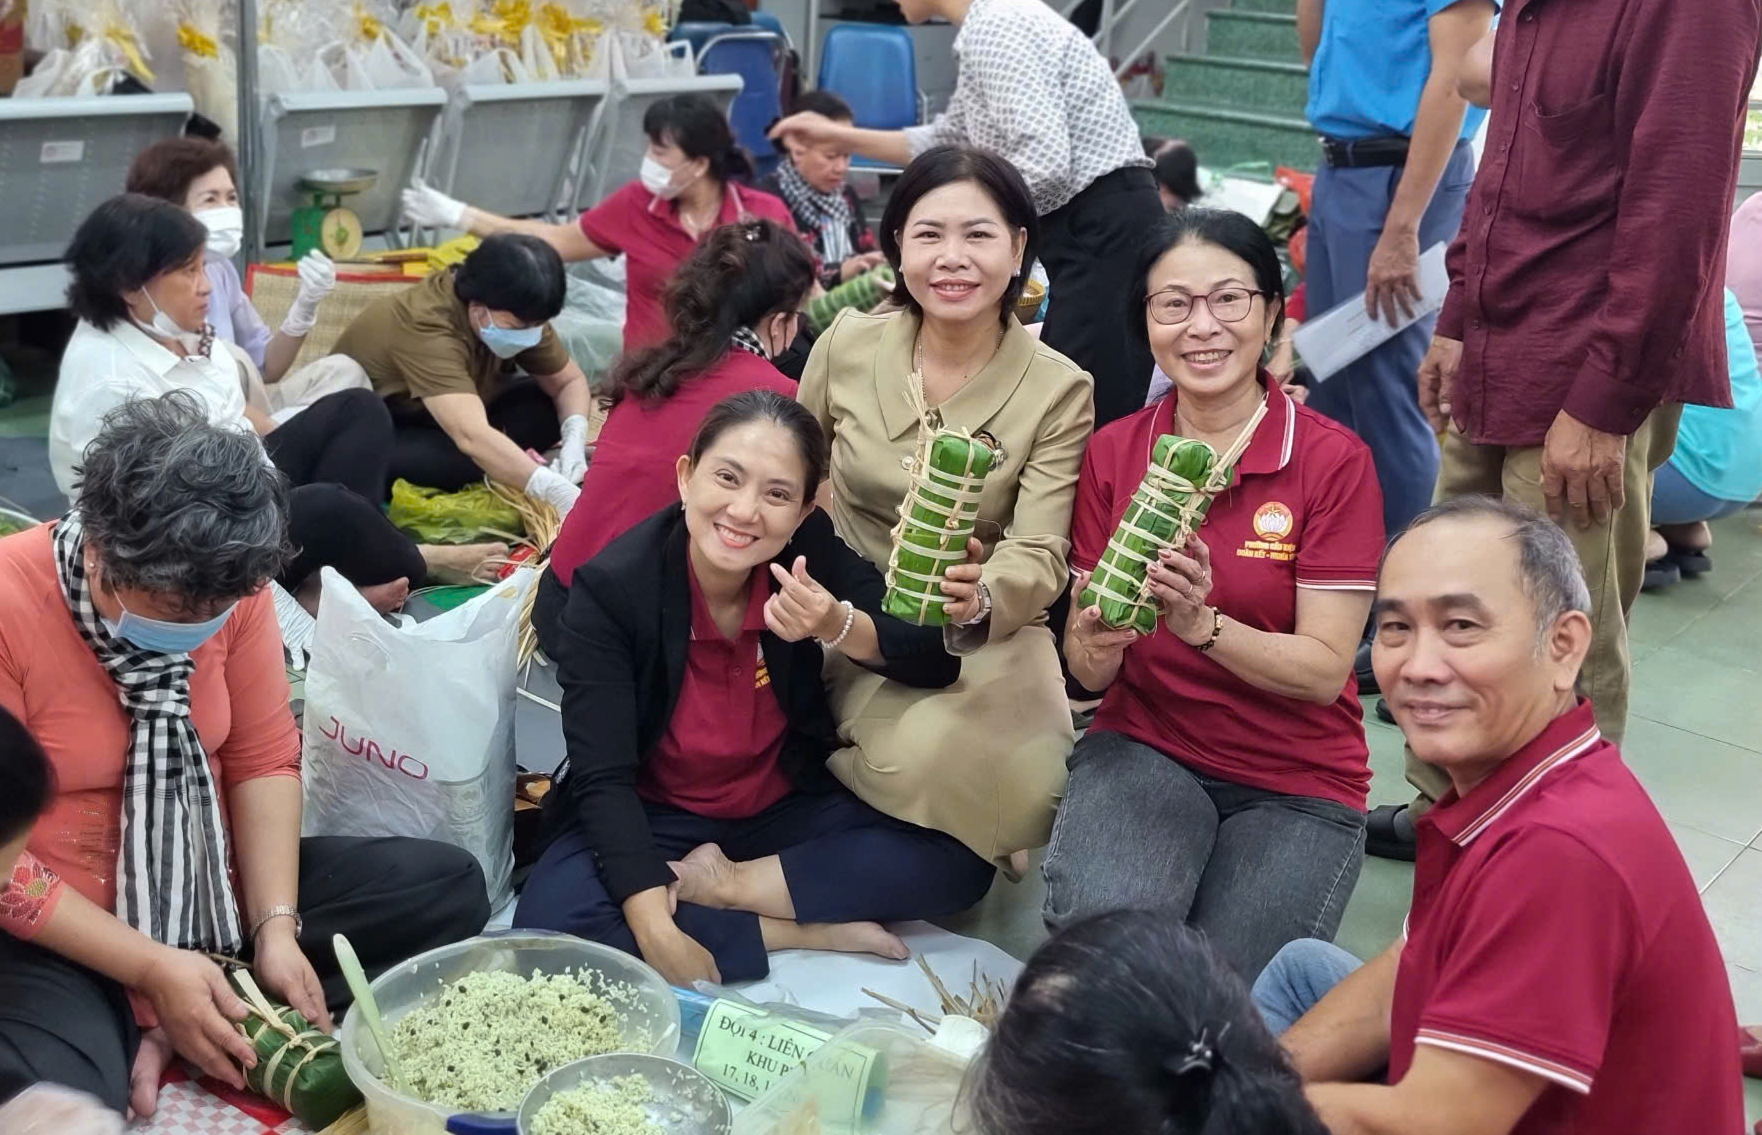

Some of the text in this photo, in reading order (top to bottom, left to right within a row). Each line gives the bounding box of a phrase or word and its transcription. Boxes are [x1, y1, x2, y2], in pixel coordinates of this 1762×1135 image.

[318, 715, 429, 780] JUNO
[748, 1031, 758, 1042] 4
[767, 1034, 805, 1060] LIÊN
[746, 1050, 778, 1073] KHU
[723, 1063, 739, 1081] 17,
[743, 1072, 759, 1092] 18,
